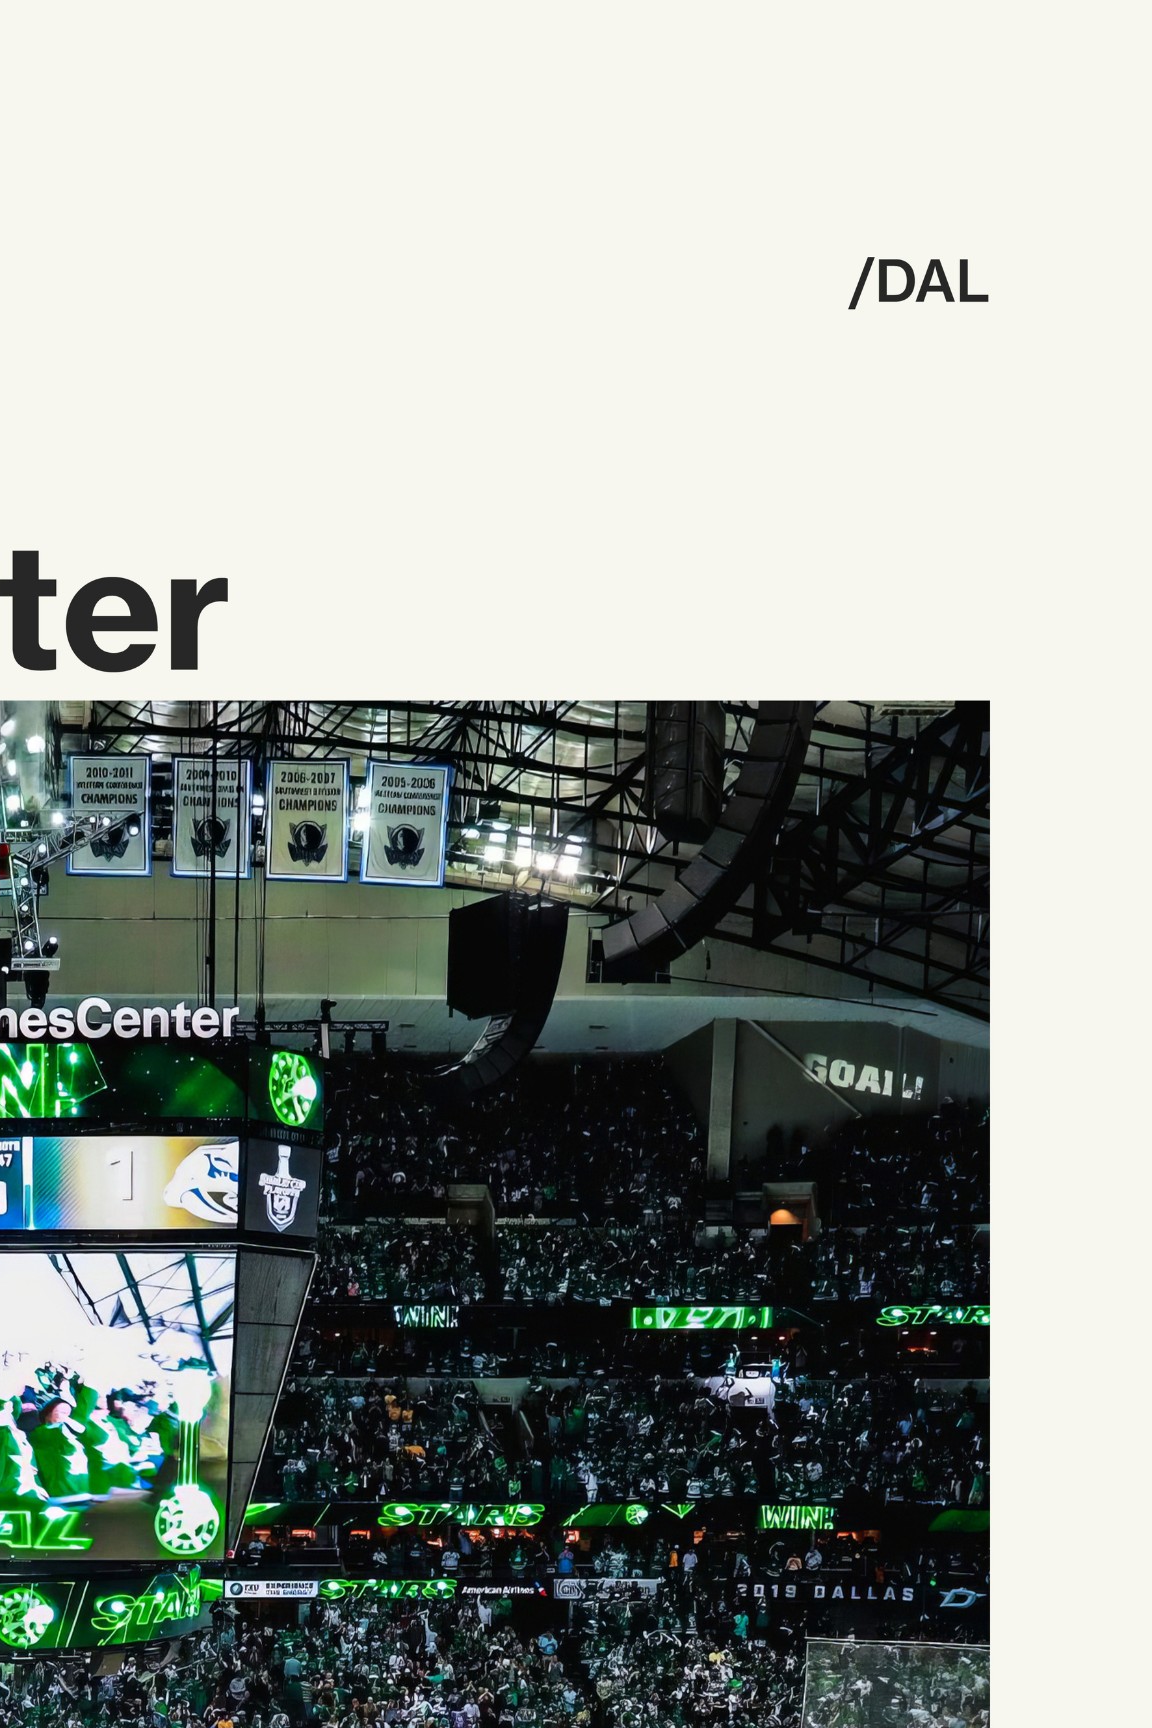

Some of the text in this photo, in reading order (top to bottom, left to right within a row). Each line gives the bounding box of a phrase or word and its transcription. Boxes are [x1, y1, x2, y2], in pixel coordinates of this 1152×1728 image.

[80, 793, 139, 805] CHAMPIONS
[182, 796, 240, 808] CHAMIONS
[278, 798, 338, 812] CHAMPIONS
[377, 802, 437, 816] CHAMPIONS
[108, 1150, 134, 1202] 1
[377, 1503, 545, 1527] STARS
[318, 1579, 458, 1600] STARS
[461, 1585, 501, 1595] American
[737, 1582, 915, 1602] 2019 DALLAS
